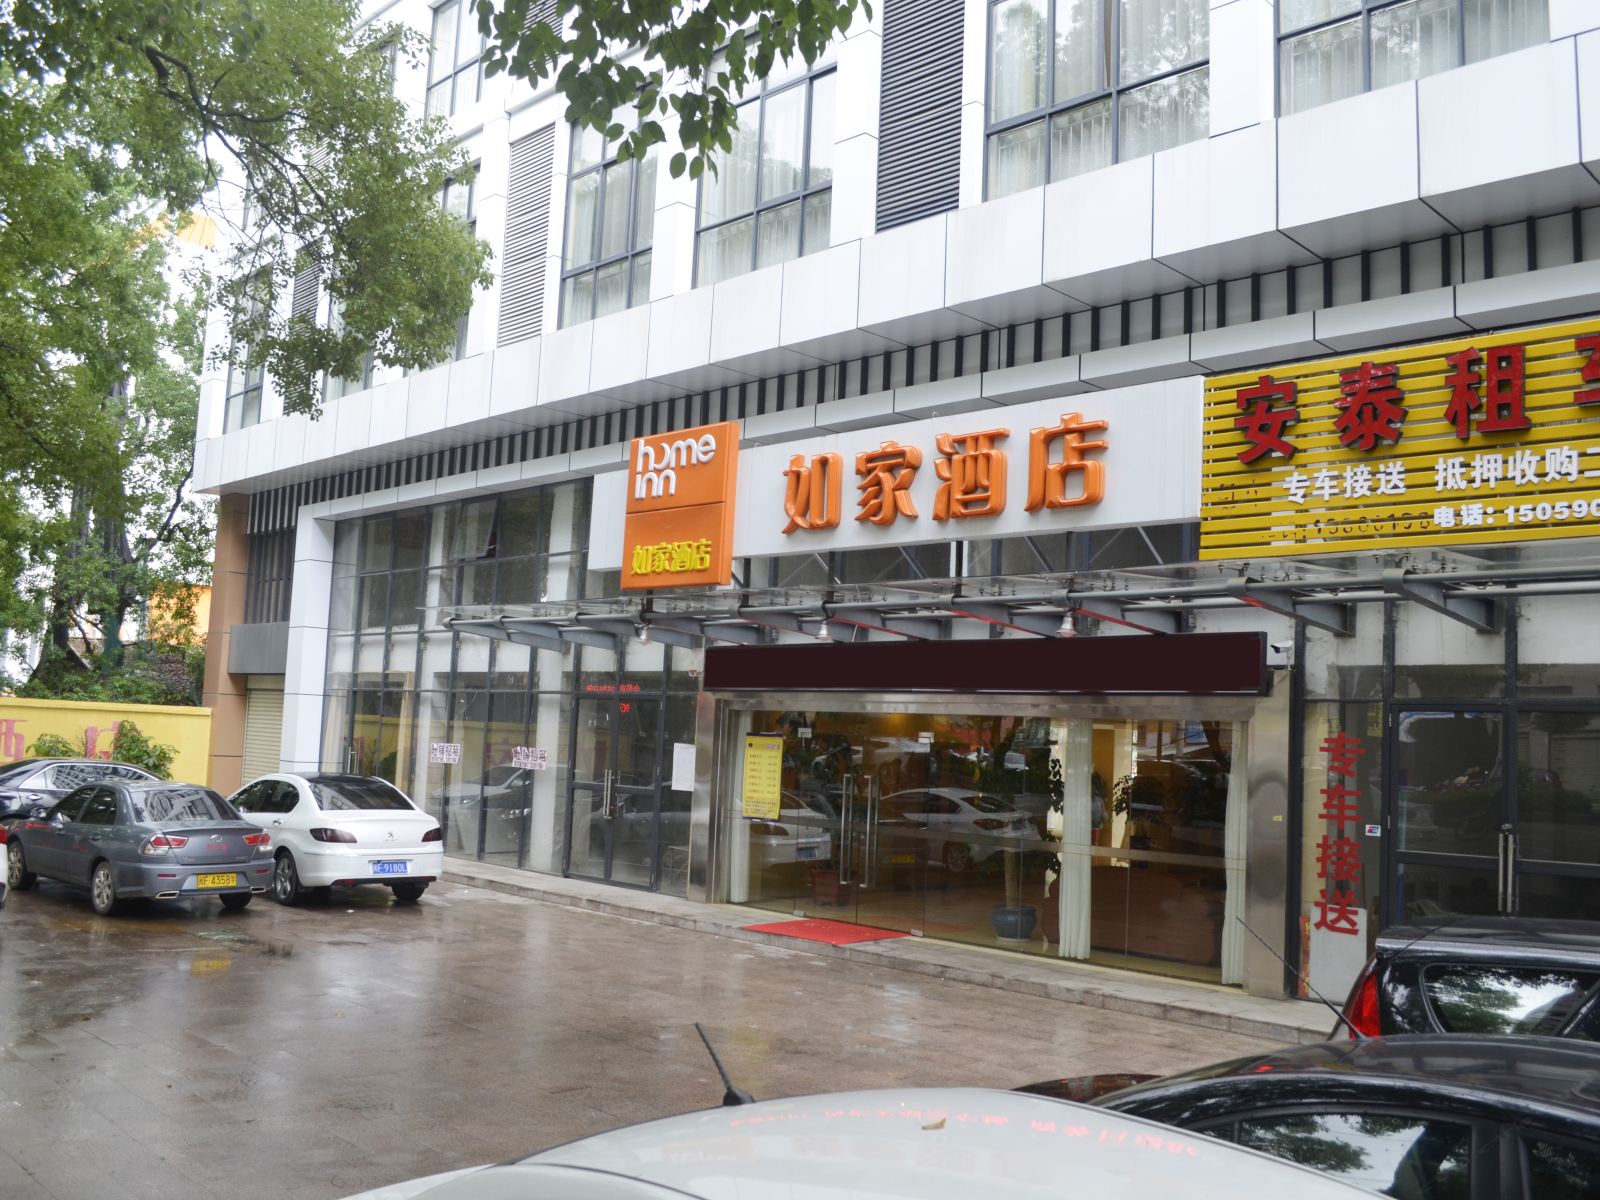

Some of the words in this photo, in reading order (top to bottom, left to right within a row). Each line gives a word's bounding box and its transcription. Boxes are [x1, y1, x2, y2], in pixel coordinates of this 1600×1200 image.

[636, 433, 716, 473] home
[782, 411, 1109, 535] 如家酒店
[634, 469, 676, 500] inn
[1282, 461, 1407, 505] 专车接送
[631, 538, 712, 576] 如家酒店
[1313, 731, 1366, 936] 专车接送
